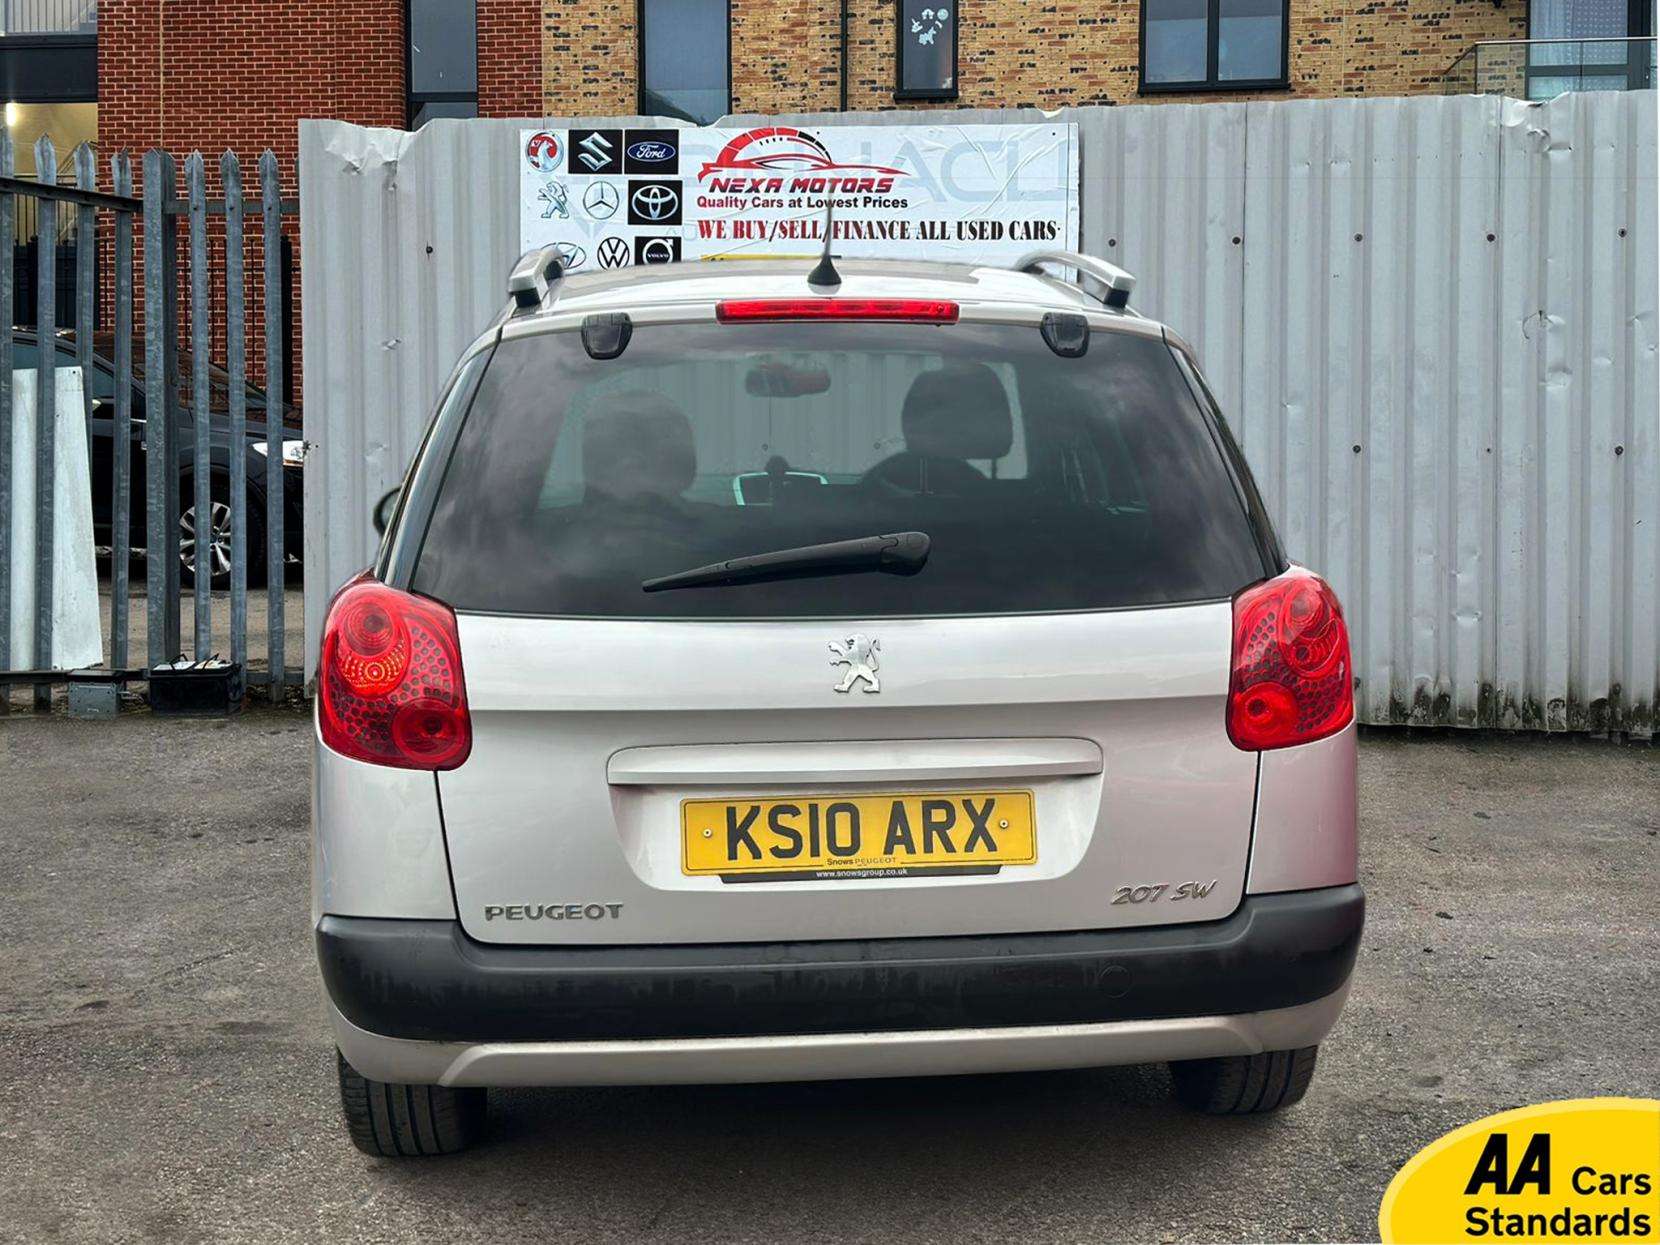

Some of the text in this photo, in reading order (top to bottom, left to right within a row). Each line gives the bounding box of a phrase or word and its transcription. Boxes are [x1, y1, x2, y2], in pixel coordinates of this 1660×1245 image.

[635, 143, 668, 159] Ford
[709, 178, 895, 194] NEXA MOTORS
[697, 196, 909, 210] Quality Cars at Lowest Prices
[697, 220, 727, 239] WE
[915, 220, 951, 240] ALL
[956, 220, 1004, 240] USED
[725, 798, 998, 861] KS10 ARX
[827, 857, 896, 866] Snows PEUGEOT
[815, 867, 909, 878] www.snowsgroup.co.uk
[1110, 879, 1219, 905] 207 SW
[484, 902, 625, 921] PEUGEOT
